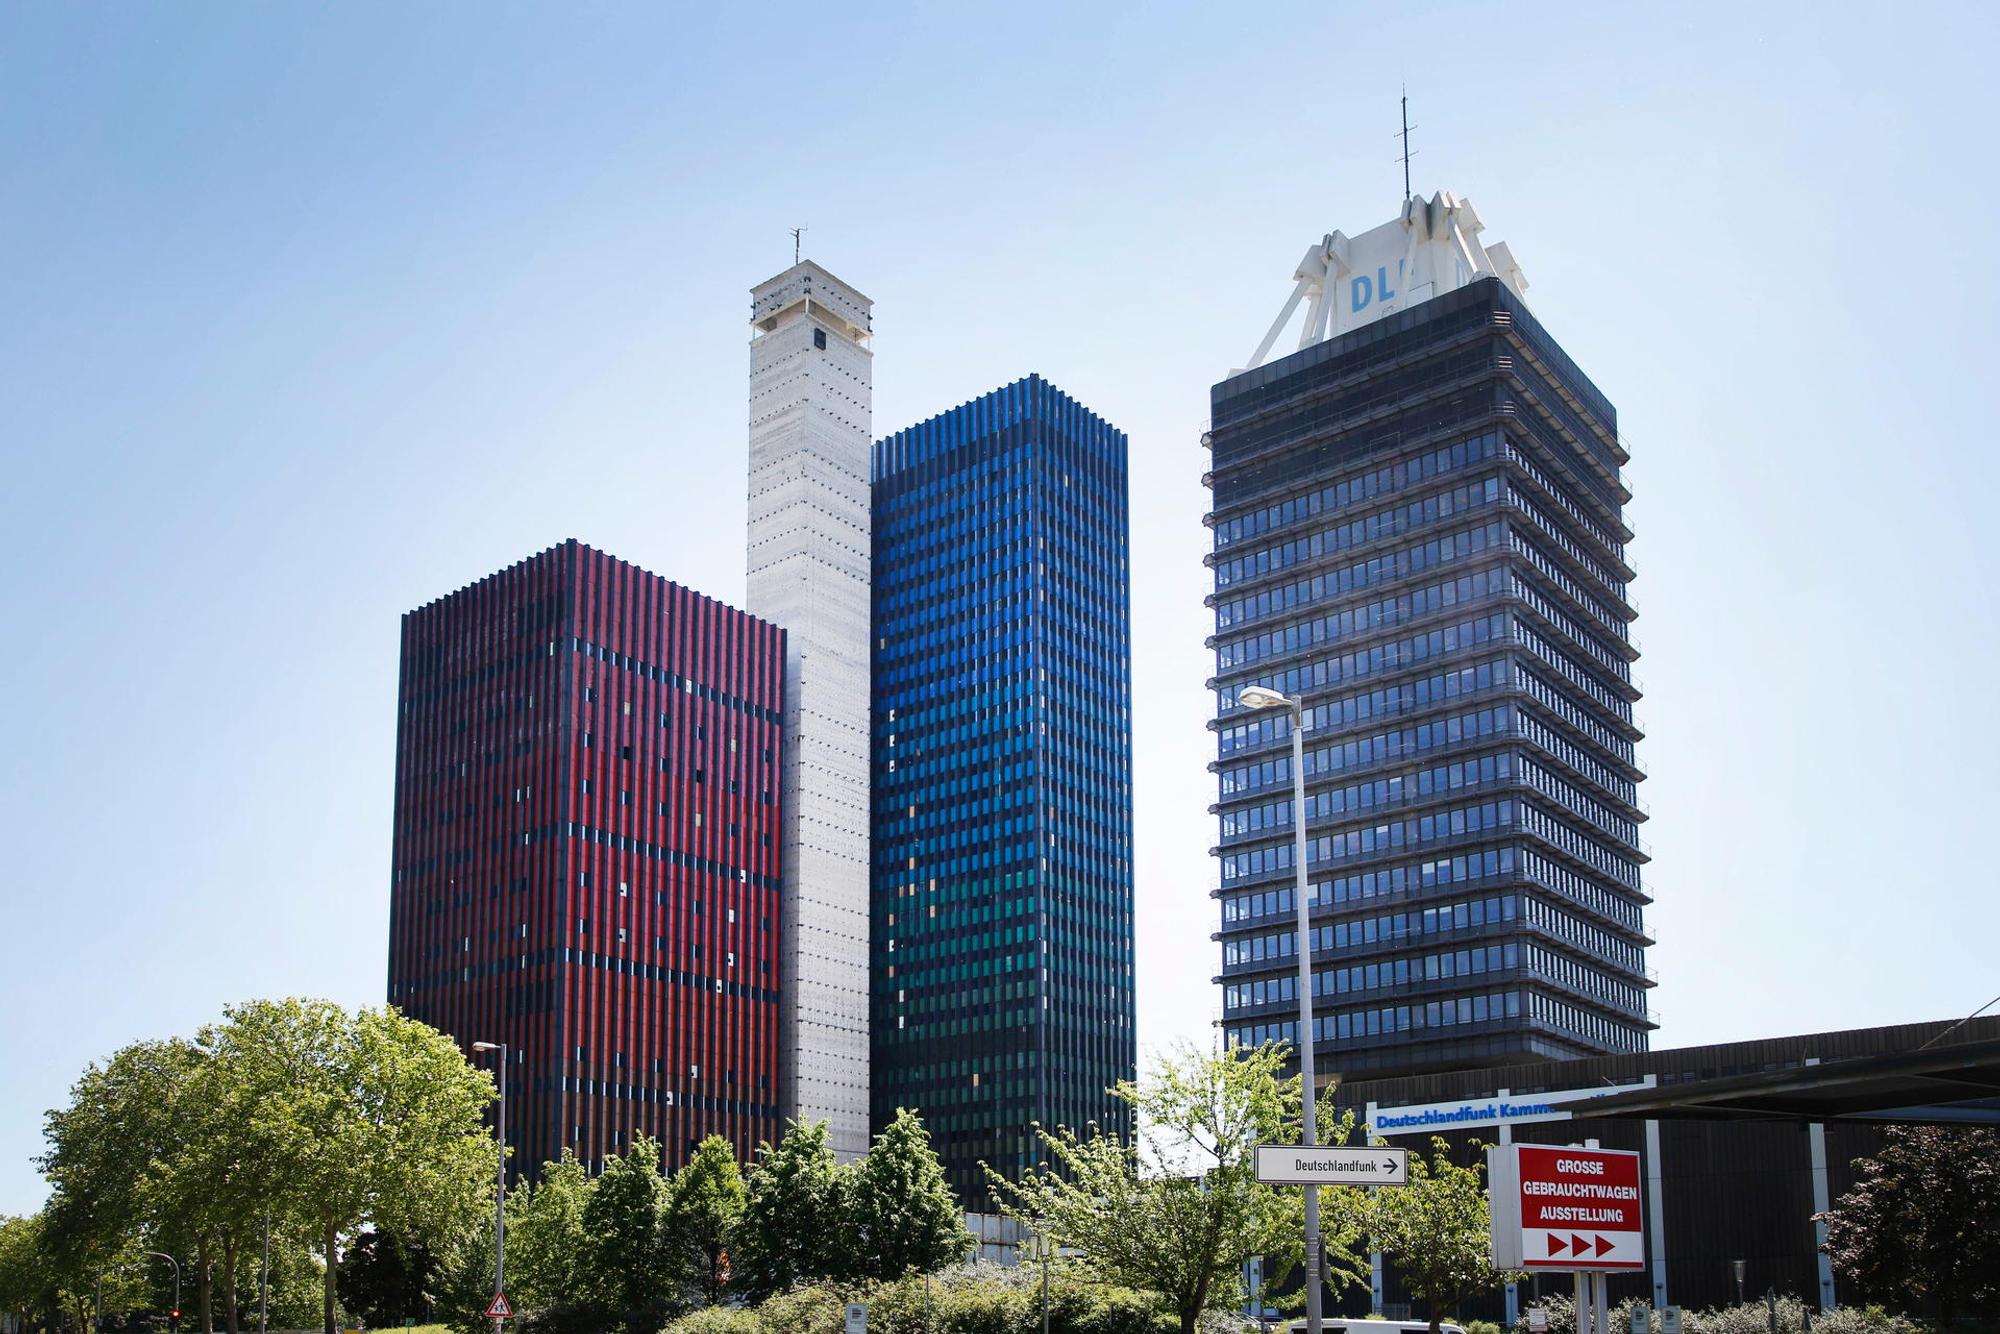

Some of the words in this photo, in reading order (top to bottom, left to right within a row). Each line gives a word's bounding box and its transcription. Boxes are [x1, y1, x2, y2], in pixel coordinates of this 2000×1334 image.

[1351, 258, 1415, 313] DL
[1376, 1104, 1497, 1129] Deutschlandfunk
[1295, 1158, 1377, 1173] Deutschlandfunk
[1556, 1159, 1604, 1175] GROSSE
[1523, 1181, 1637, 1200] GEBRAUCHTWAGEN
[1540, 1206, 1624, 1223] AUSSTELLUNG
